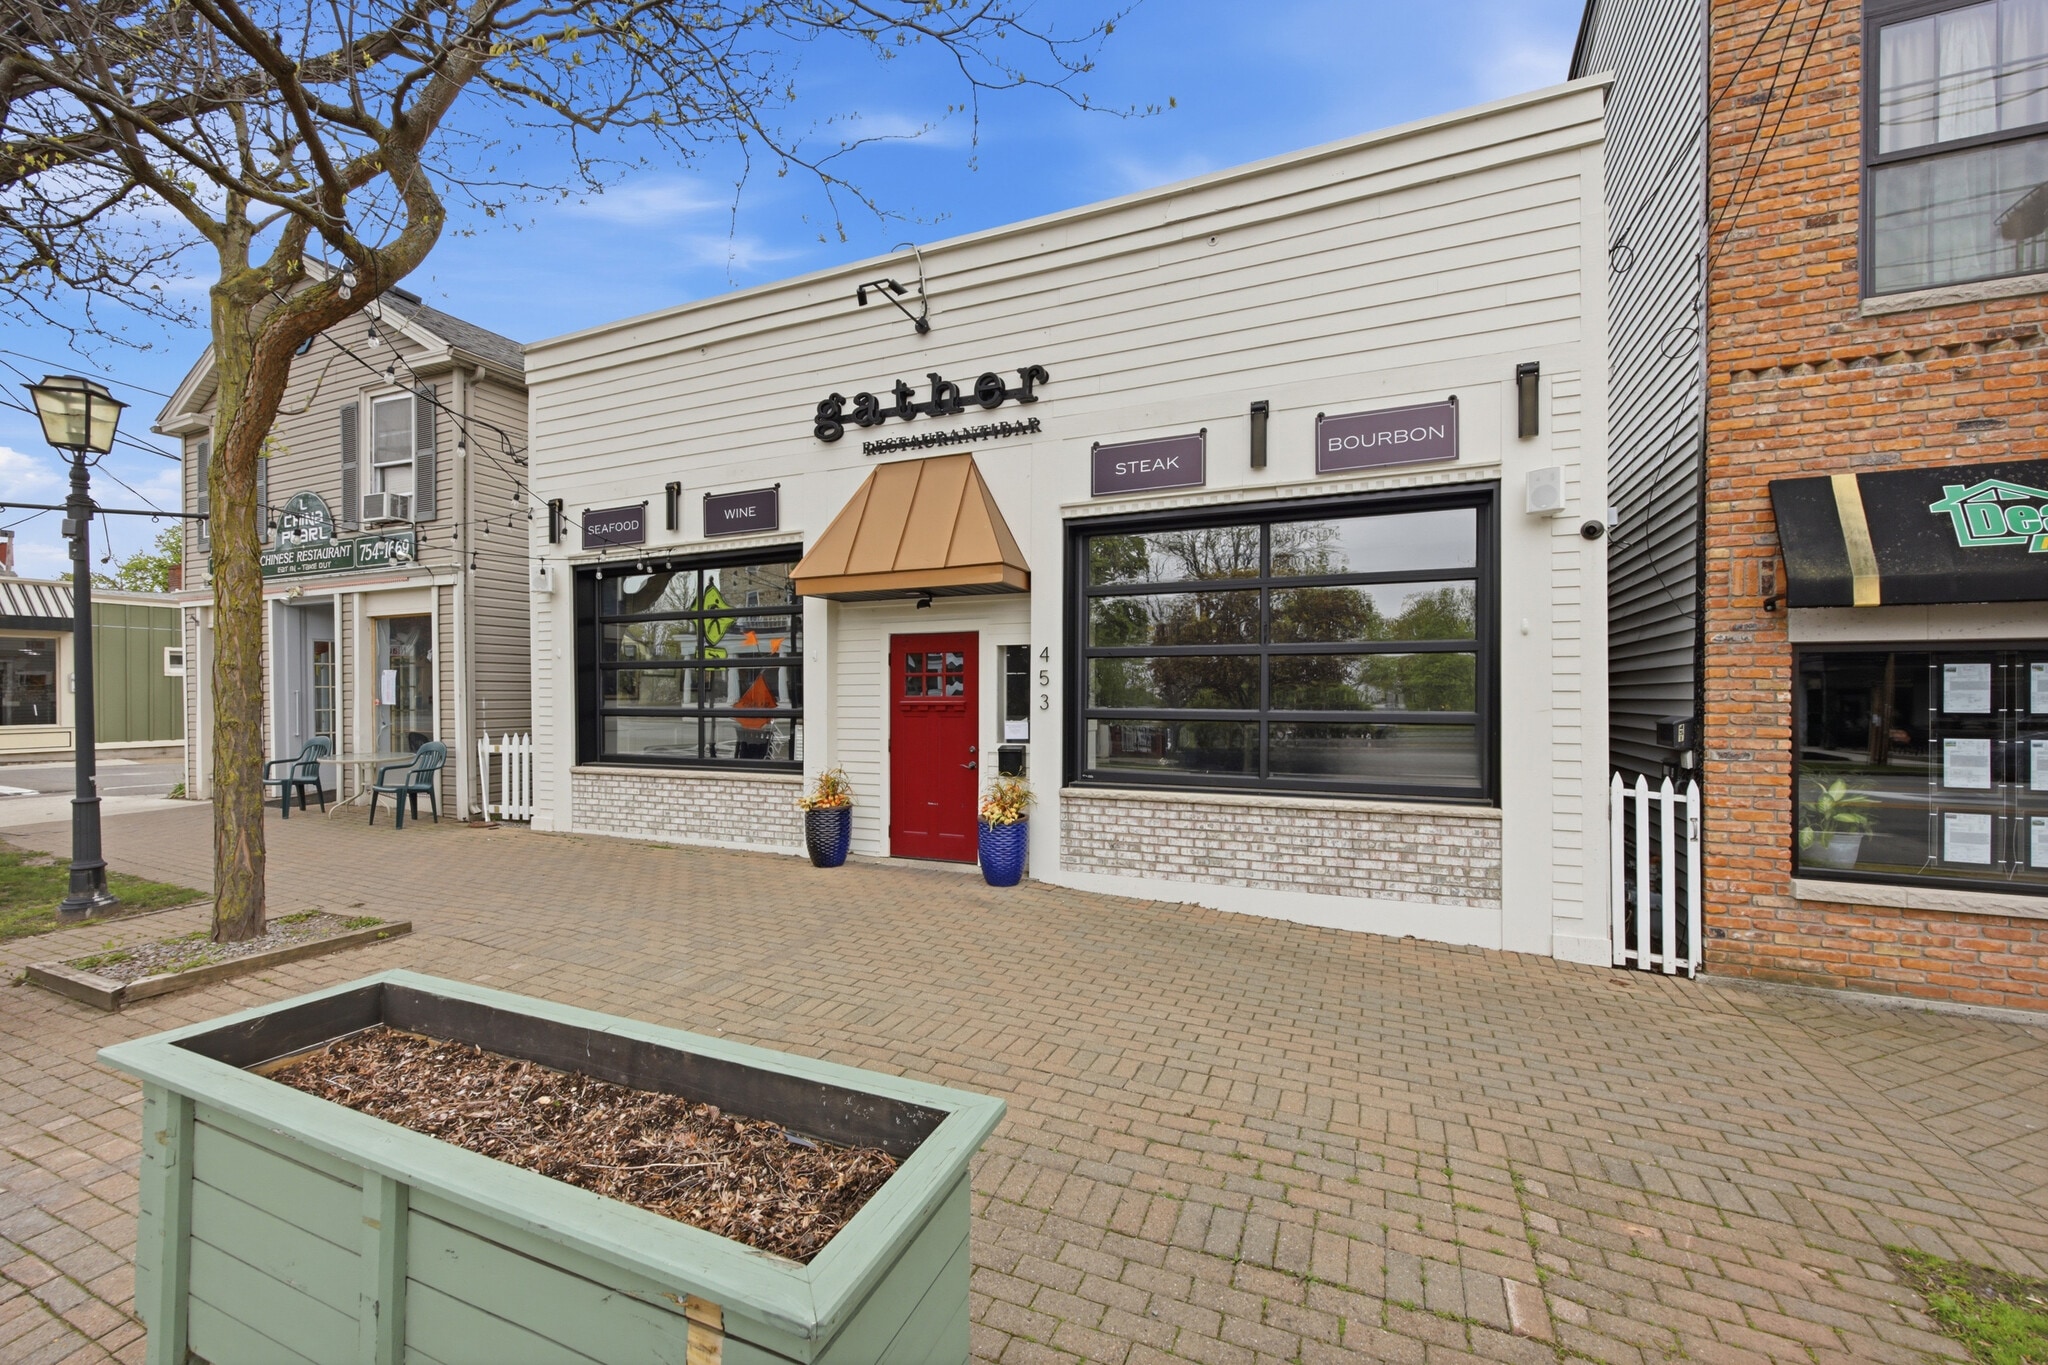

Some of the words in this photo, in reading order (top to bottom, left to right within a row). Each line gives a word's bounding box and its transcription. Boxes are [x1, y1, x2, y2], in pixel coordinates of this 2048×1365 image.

[814, 364, 1049, 442] gather
[1328, 424, 1445, 452] BOURBON
[1115, 456, 1180, 475] STEAK
[724, 506, 757, 520] WINE
[588, 520, 639, 536] SEAFOOD
[260, 551, 295, 567] CHINESE
[297, 544, 352, 563] RESTAURANT
[301, 563, 318, 571] TAKE
[318, 561, 332, 569] OUT
